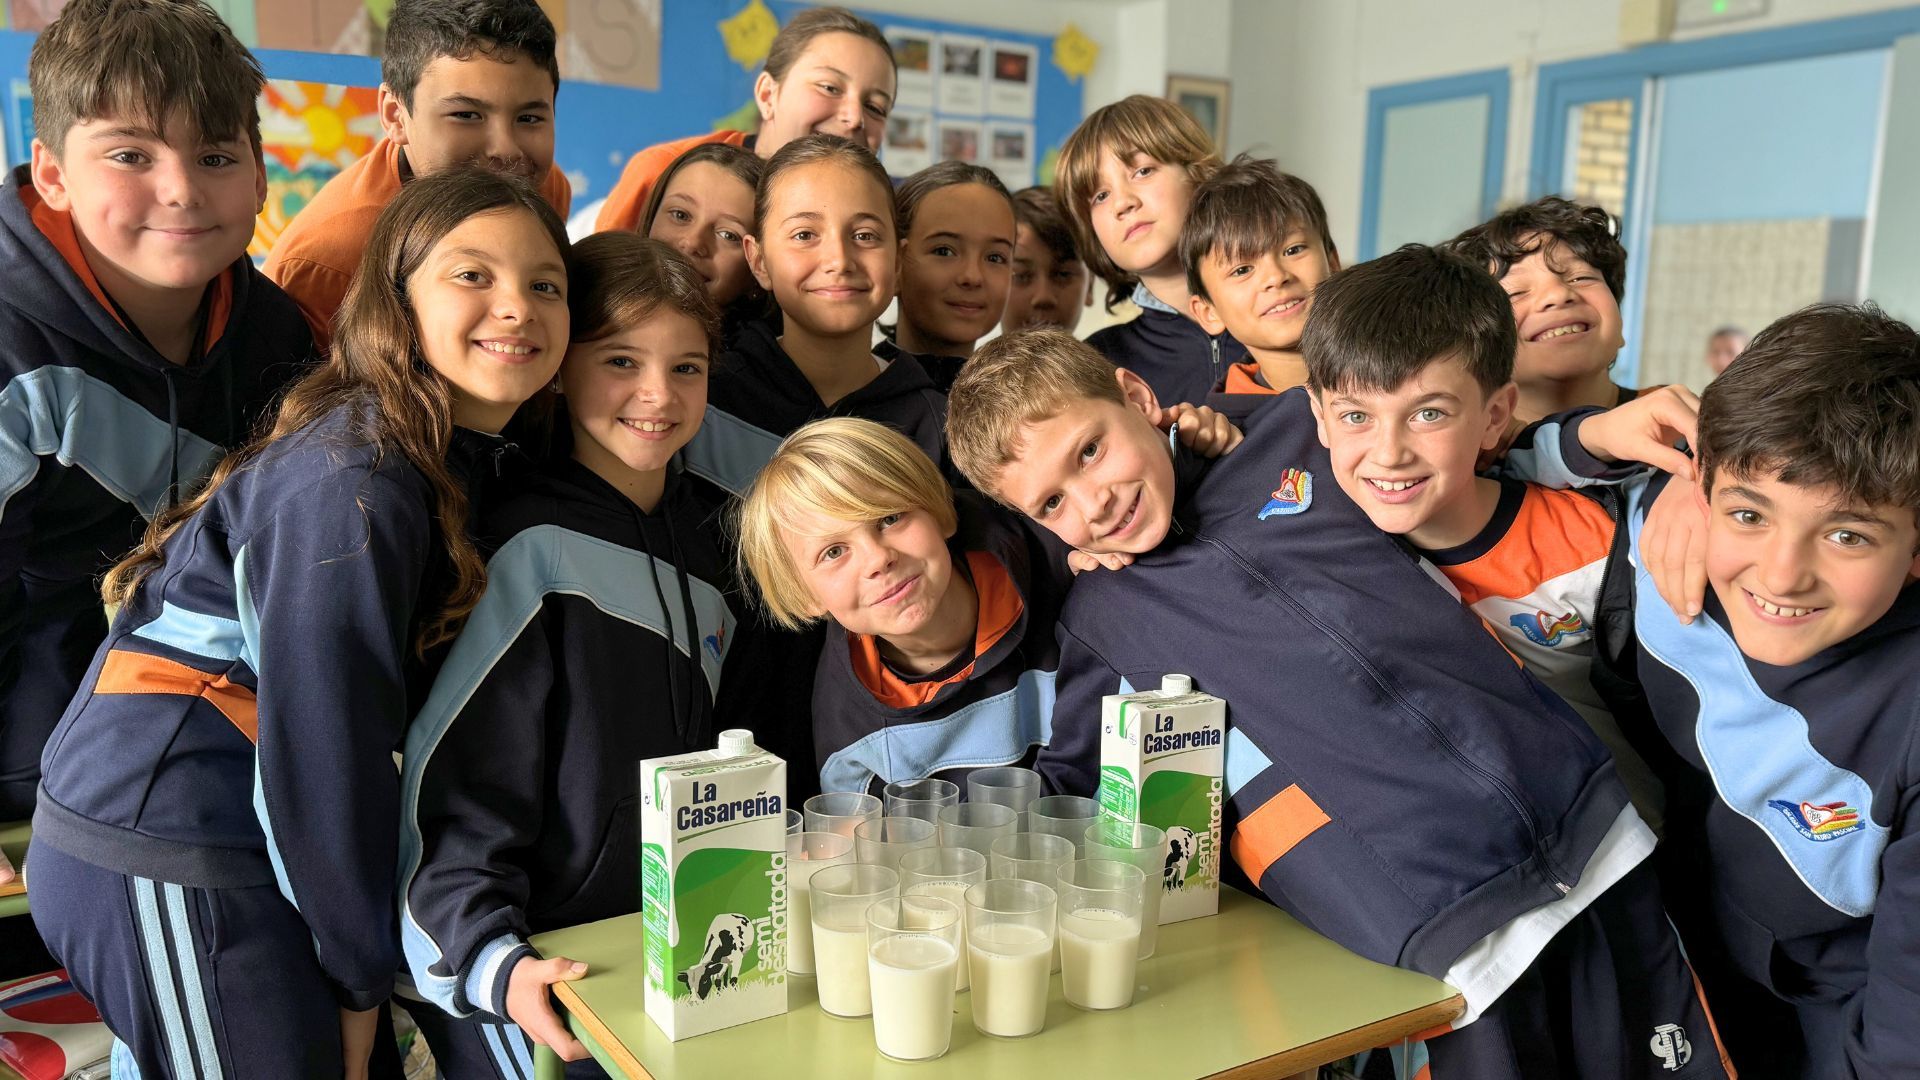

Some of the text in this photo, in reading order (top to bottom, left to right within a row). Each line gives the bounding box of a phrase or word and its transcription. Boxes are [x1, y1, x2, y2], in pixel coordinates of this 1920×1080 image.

[1143, 724, 1221, 755] Casareña
[1155, 713, 1174, 734] La
[677, 790, 782, 831] Casareña
[692, 781, 717, 805] La
[1195, 831, 1211, 878] semi
[765, 850, 787, 985] desnatada
[752, 915, 773, 973] semi
